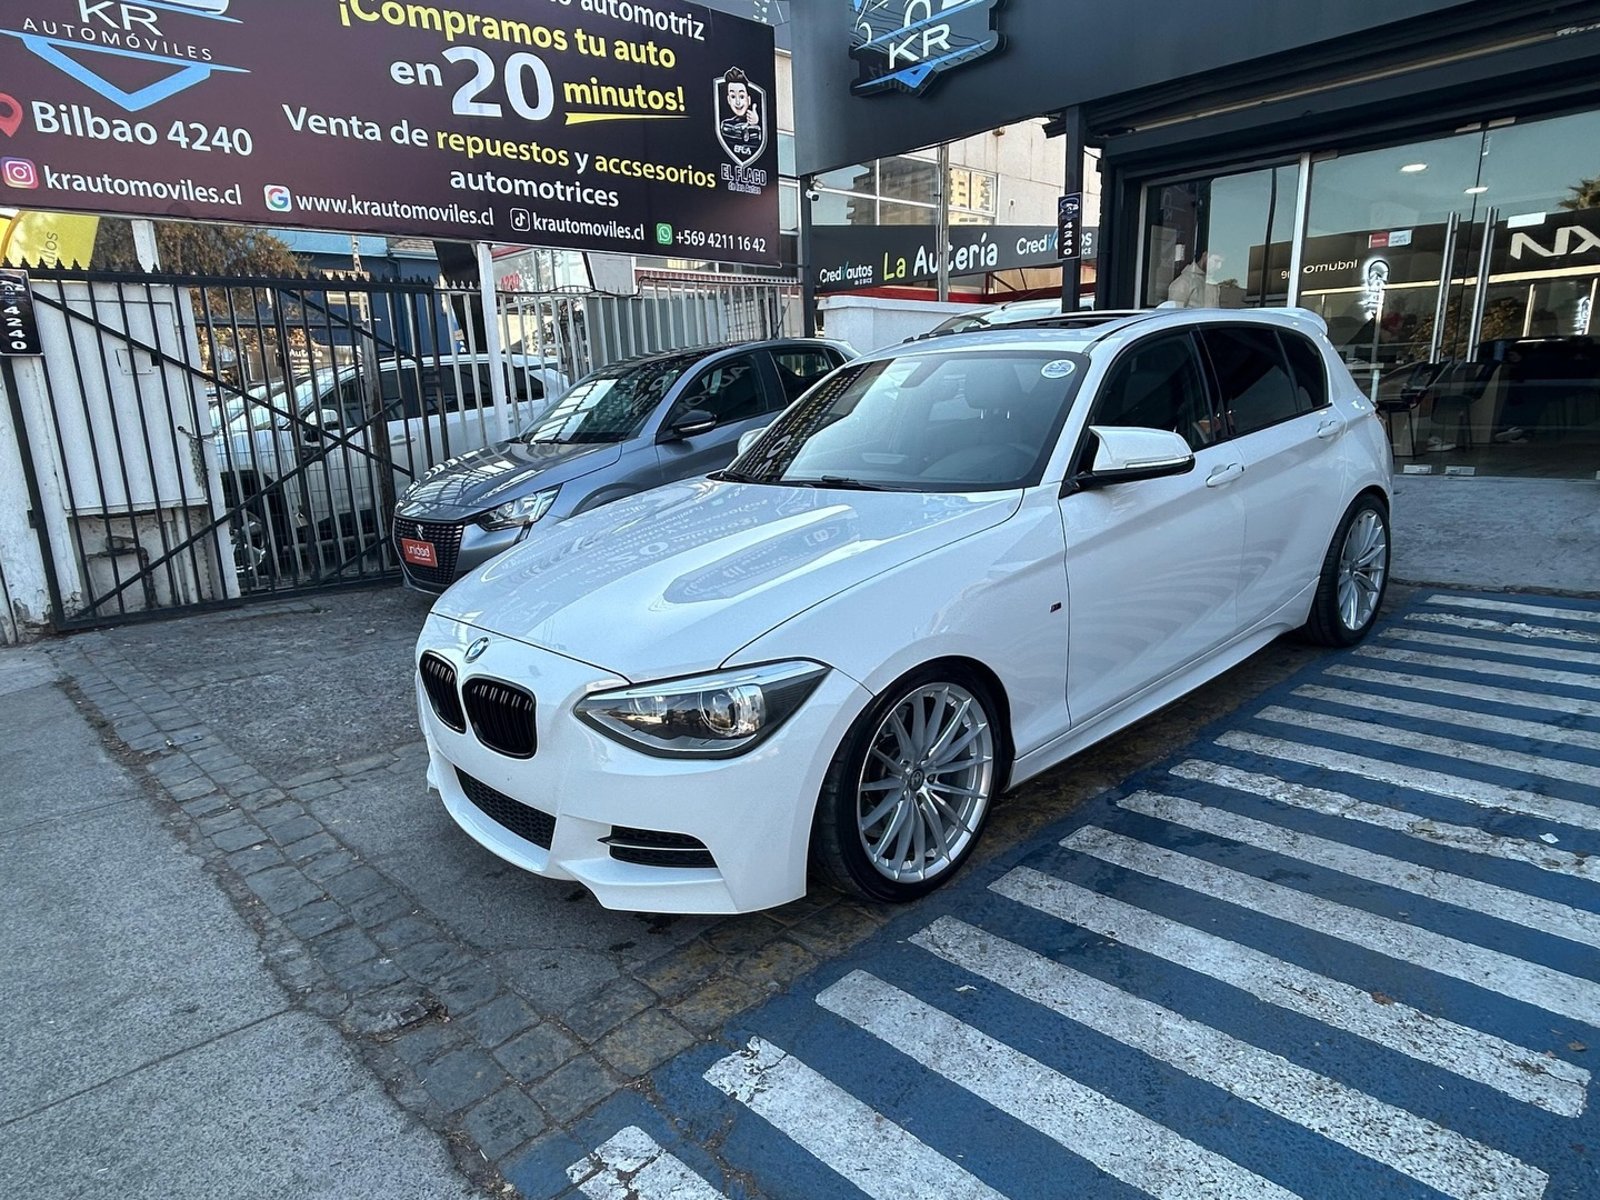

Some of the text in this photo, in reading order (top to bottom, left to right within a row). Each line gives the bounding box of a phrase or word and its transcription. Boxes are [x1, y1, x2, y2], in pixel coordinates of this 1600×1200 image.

[23, 17, 212, 61] AUTOMÓVILES
[78, 0, 163, 37] KR
[338, 0, 676, 69] ¡Compramos tu auto
[581, 0, 705, 41] automotriz
[889, 24, 950, 70] KR
[390, 45, 686, 121] en 20 minutos!
[32, 101, 253, 156] Bilbao 4240
[282, 103, 716, 188] Venta de repuestos y accsesorios
[44, 165, 243, 206] krautomoviles.cl
[450, 170, 619, 208] automotrices
[720, 163, 767, 187] EL FLACO
[295, 194, 495, 226] www.krautomoviles.cl
[533, 212, 645, 241] krautomoviles.cl
[676, 231, 706, 246] +569
[707, 231, 734, 250] 4211
[1063, 221, 1073, 255] 4240
[884, 251, 906, 281] La
[4, 305, 28, 350] 4240
